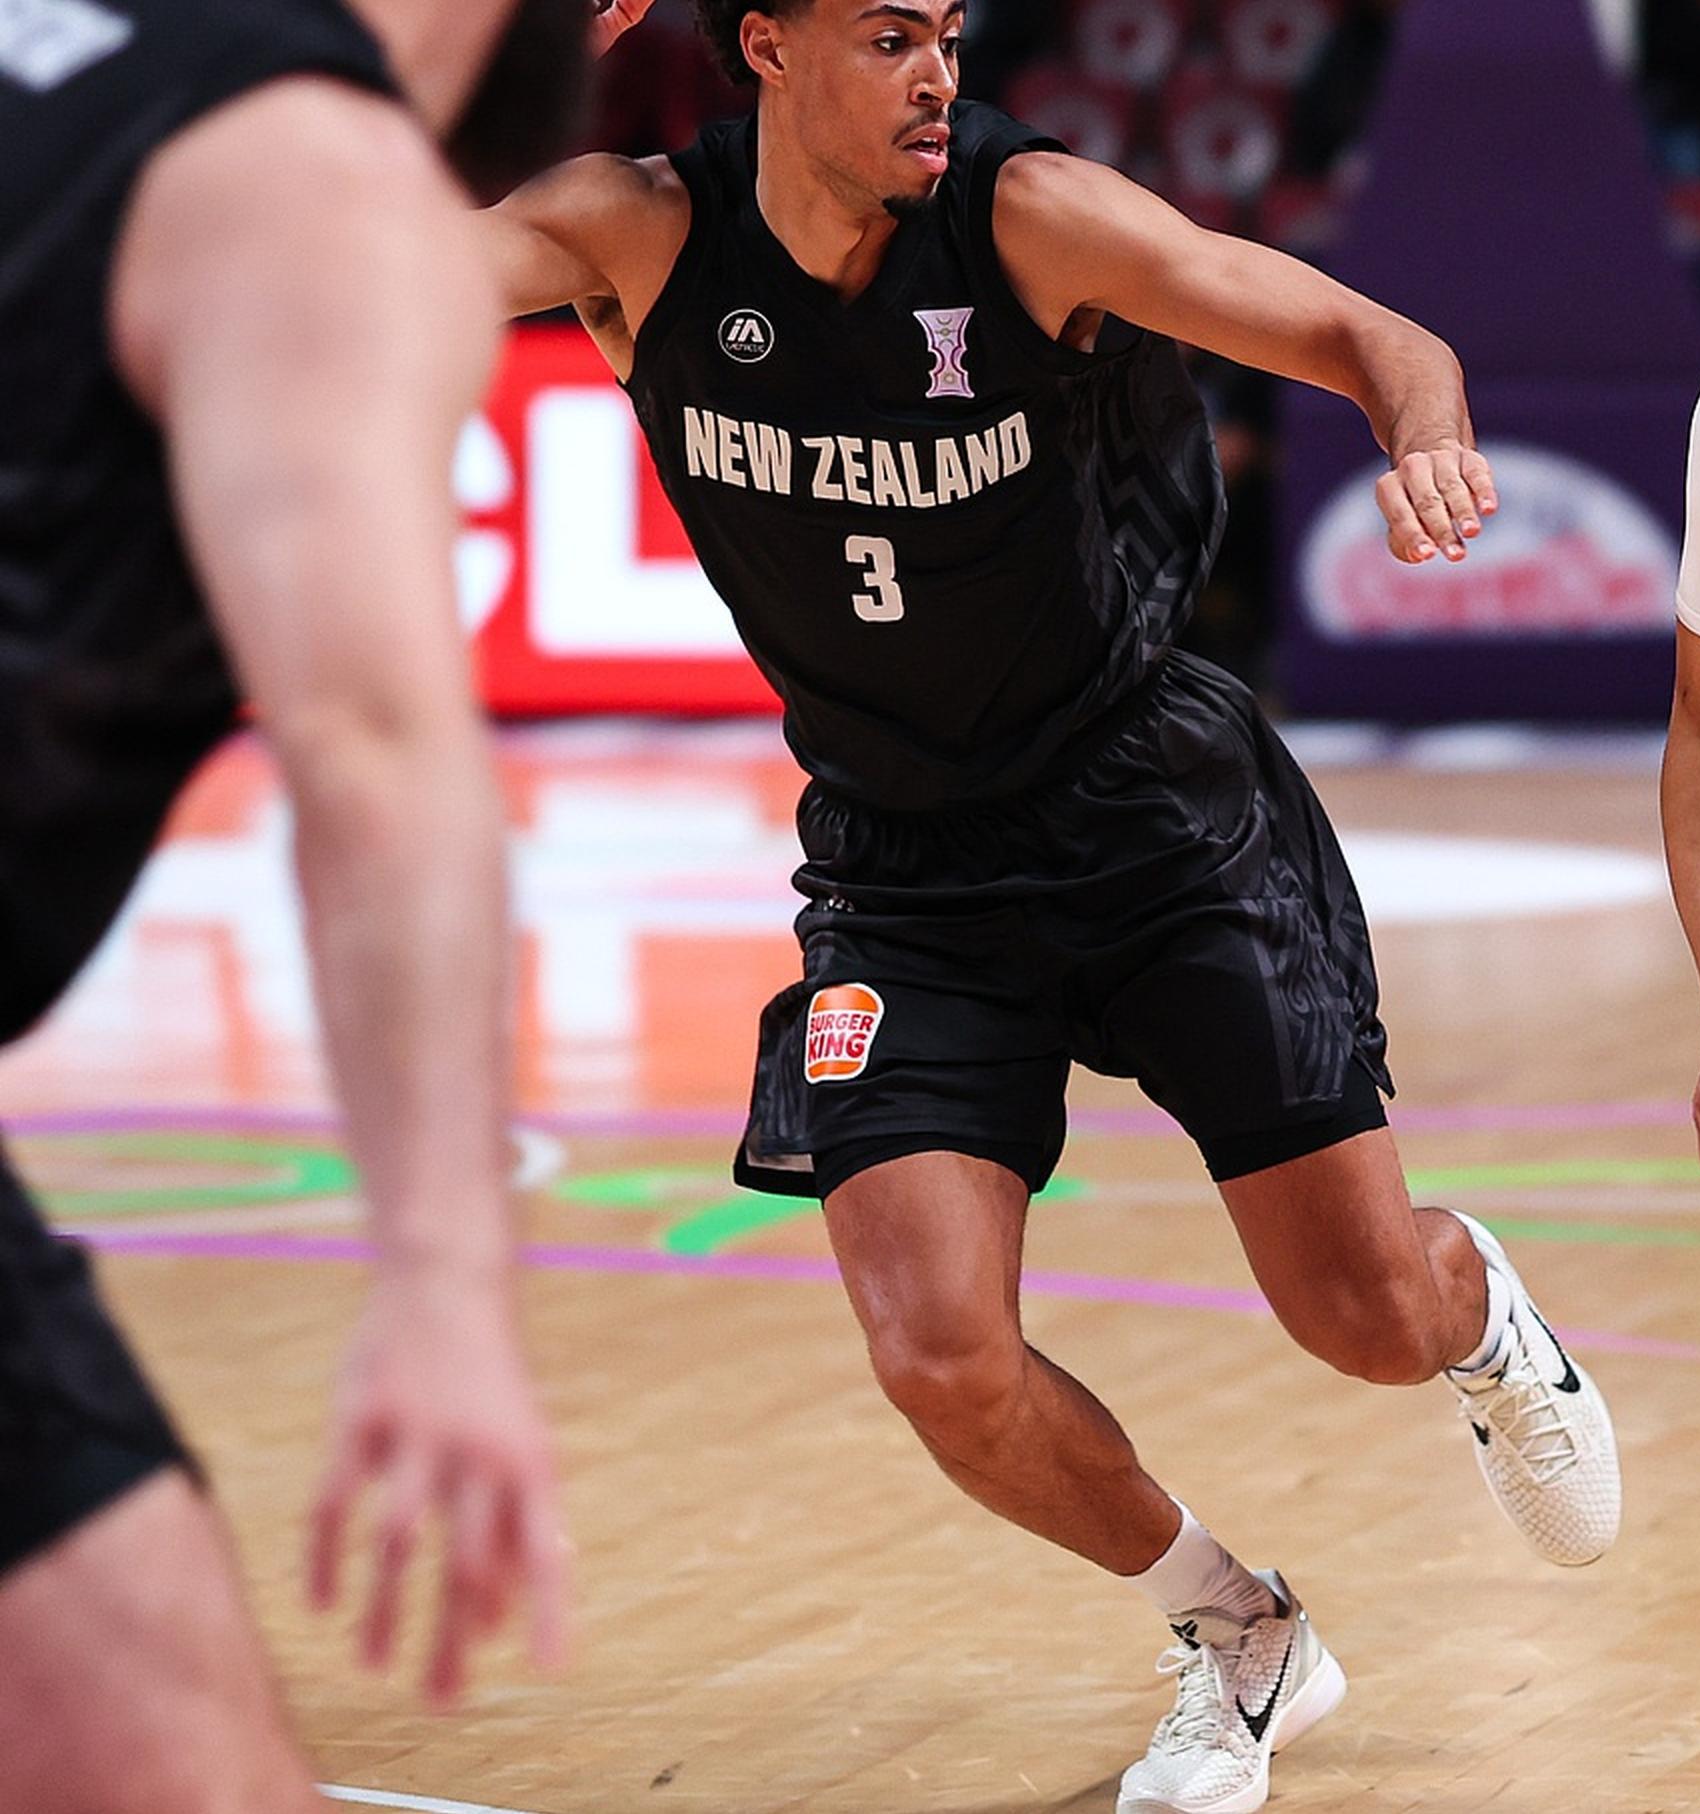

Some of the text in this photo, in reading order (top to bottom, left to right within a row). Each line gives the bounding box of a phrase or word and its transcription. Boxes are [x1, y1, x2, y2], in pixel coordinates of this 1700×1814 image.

[683, 406, 1032, 508] NEW ZEALAND
[845, 535, 904, 622] 3
[808, 1033, 867, 1063] KING
[810, 1013, 875, 1035] BURGER
